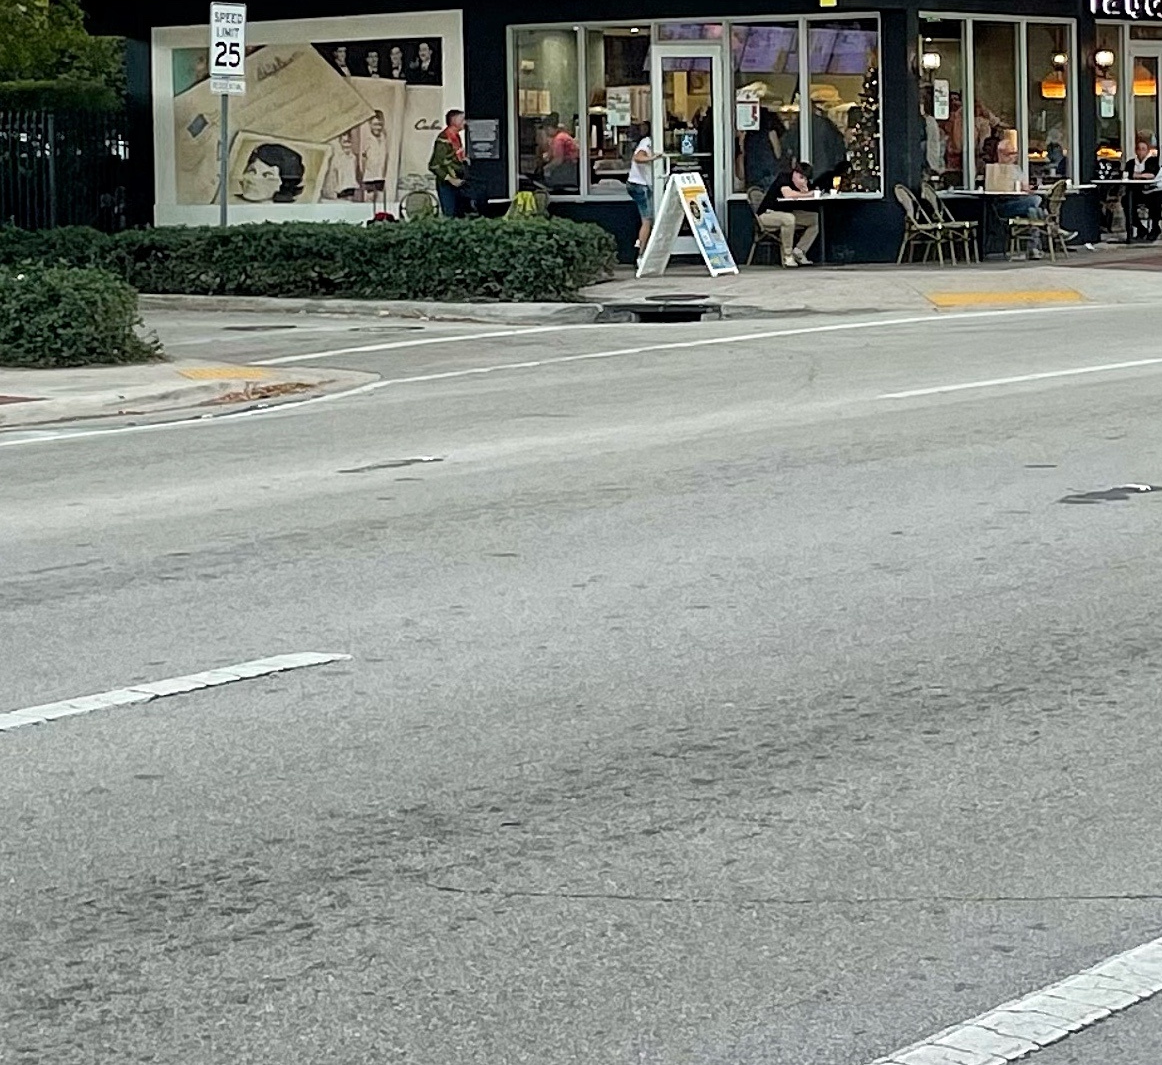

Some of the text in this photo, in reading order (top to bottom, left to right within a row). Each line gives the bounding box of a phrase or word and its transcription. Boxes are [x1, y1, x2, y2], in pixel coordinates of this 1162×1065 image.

[214, 11, 244, 25] SPEED
[216, 27, 240, 38] LIMIT
[214, 41, 241, 68] 25
